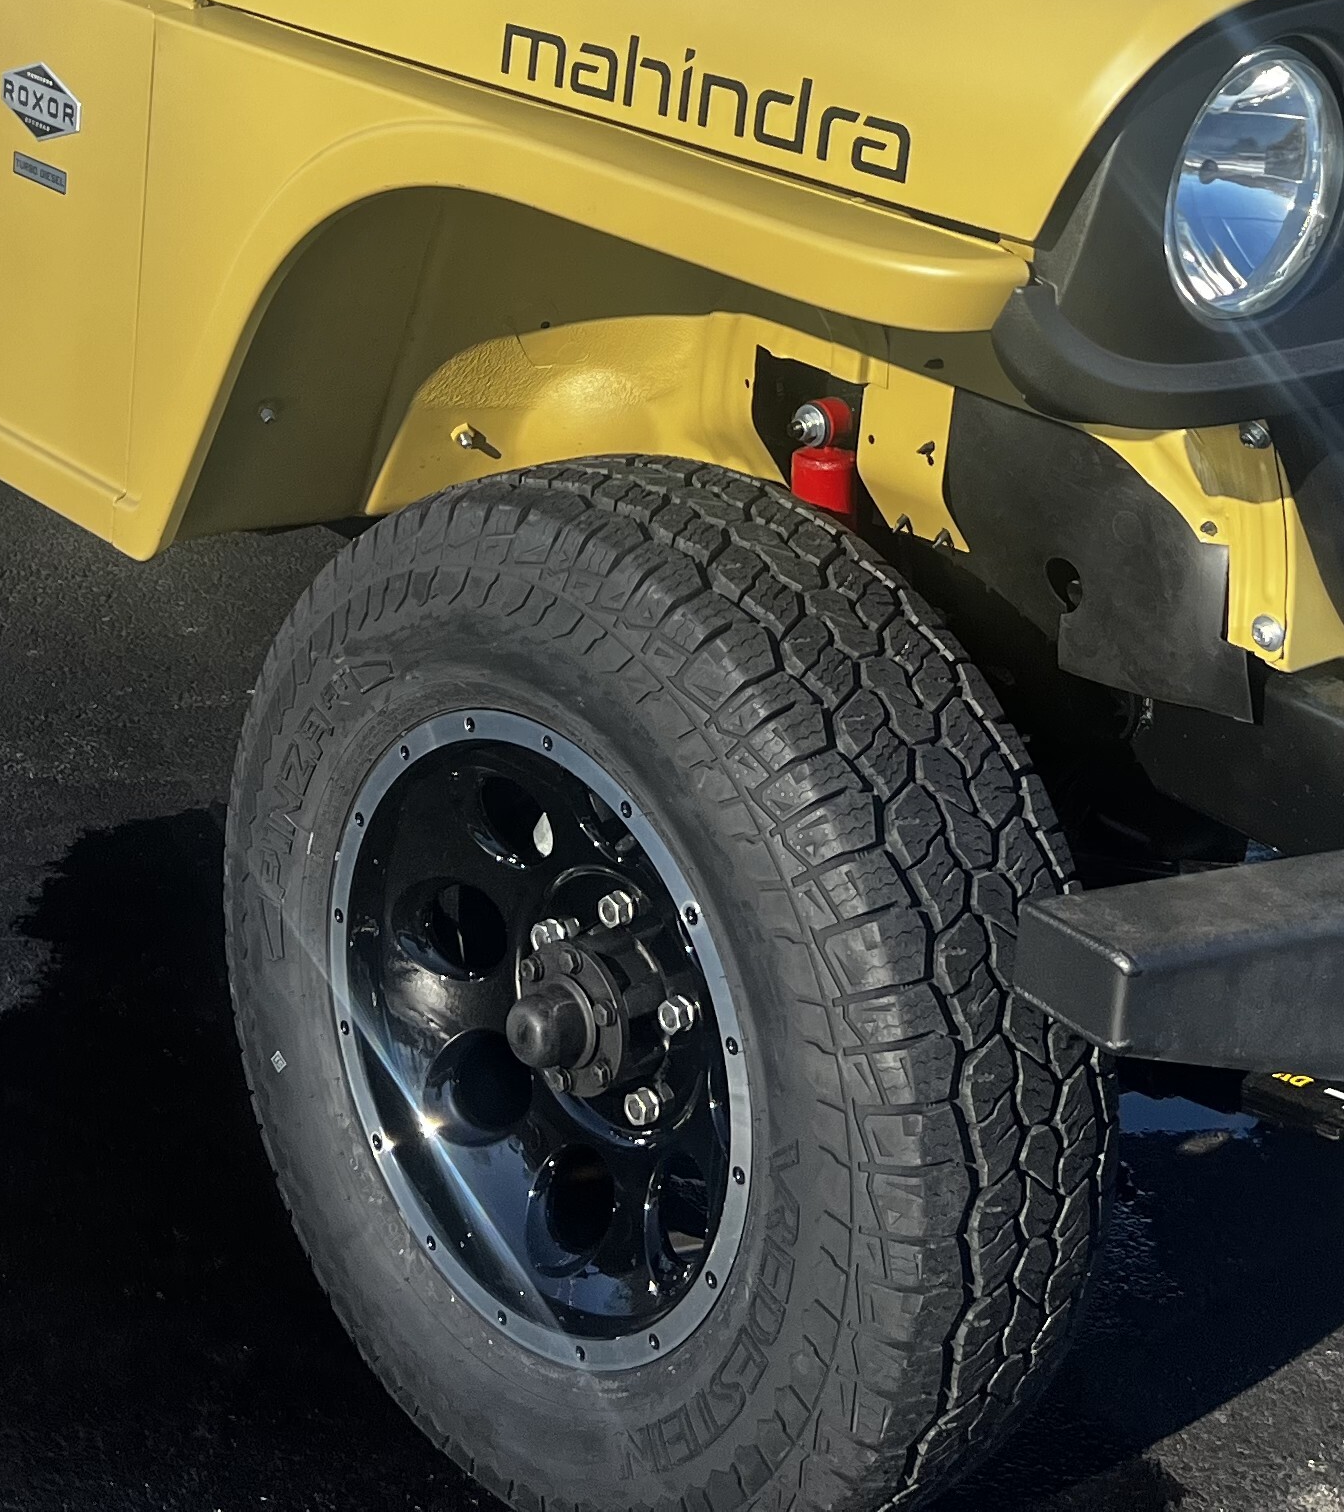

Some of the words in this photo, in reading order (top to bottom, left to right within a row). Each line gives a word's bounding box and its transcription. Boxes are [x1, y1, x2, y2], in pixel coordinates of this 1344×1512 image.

[4, 79, 74, 126] ROXOR
[501, 23, 911, 184] mahindra
[618, 1138, 801, 1481] VREDESTEIN
